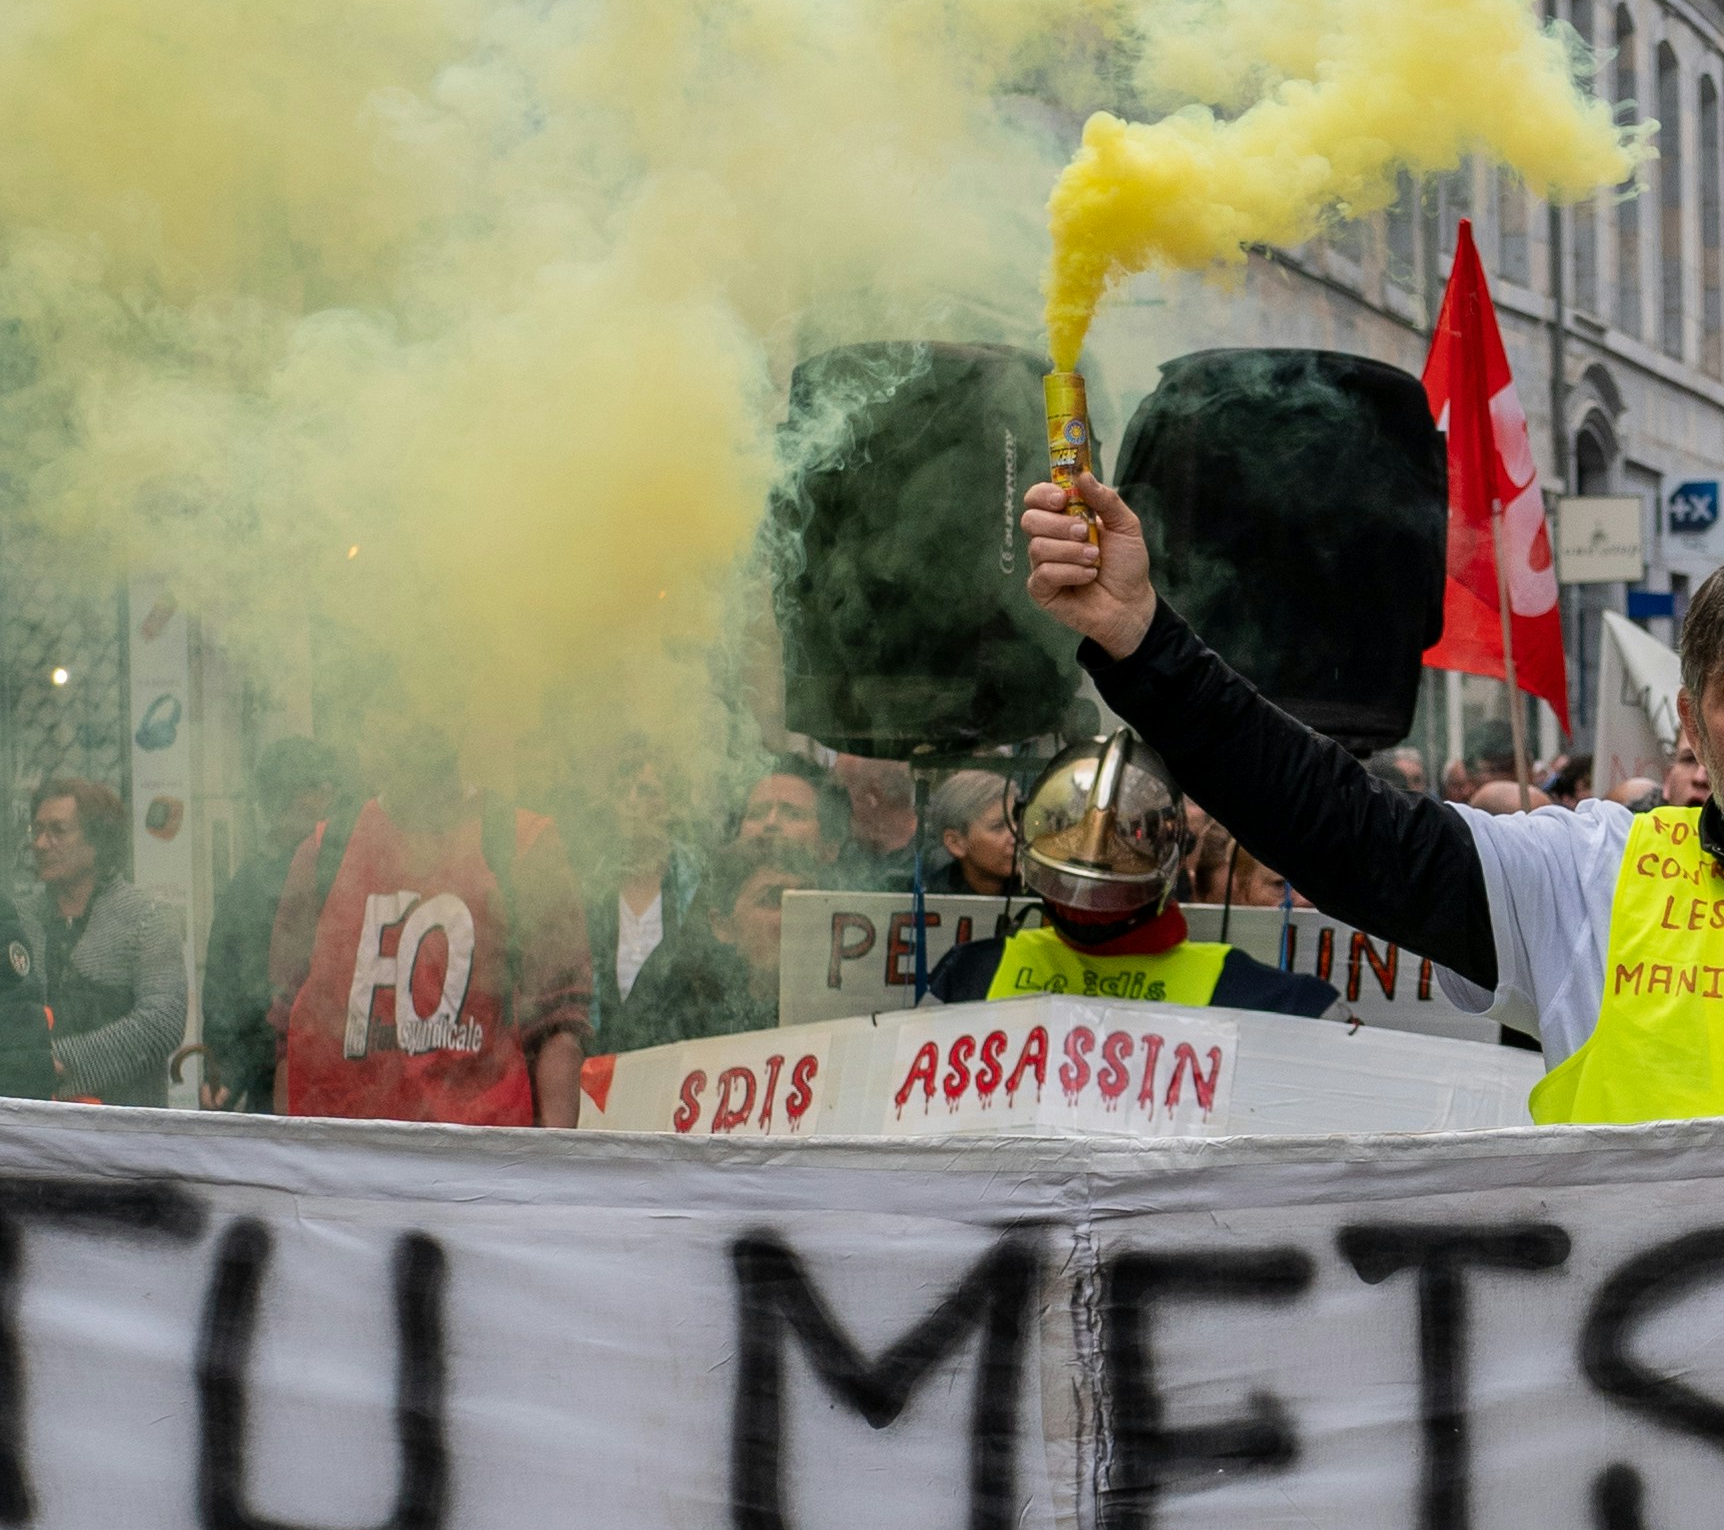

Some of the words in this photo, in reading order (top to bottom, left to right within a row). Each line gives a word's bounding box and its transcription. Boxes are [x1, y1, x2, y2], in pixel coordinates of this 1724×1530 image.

[344, 890, 475, 1061] FO
[673, 1053, 819, 1133] SDIS
[894, 1025, 1221, 1123] ASSASSIN
